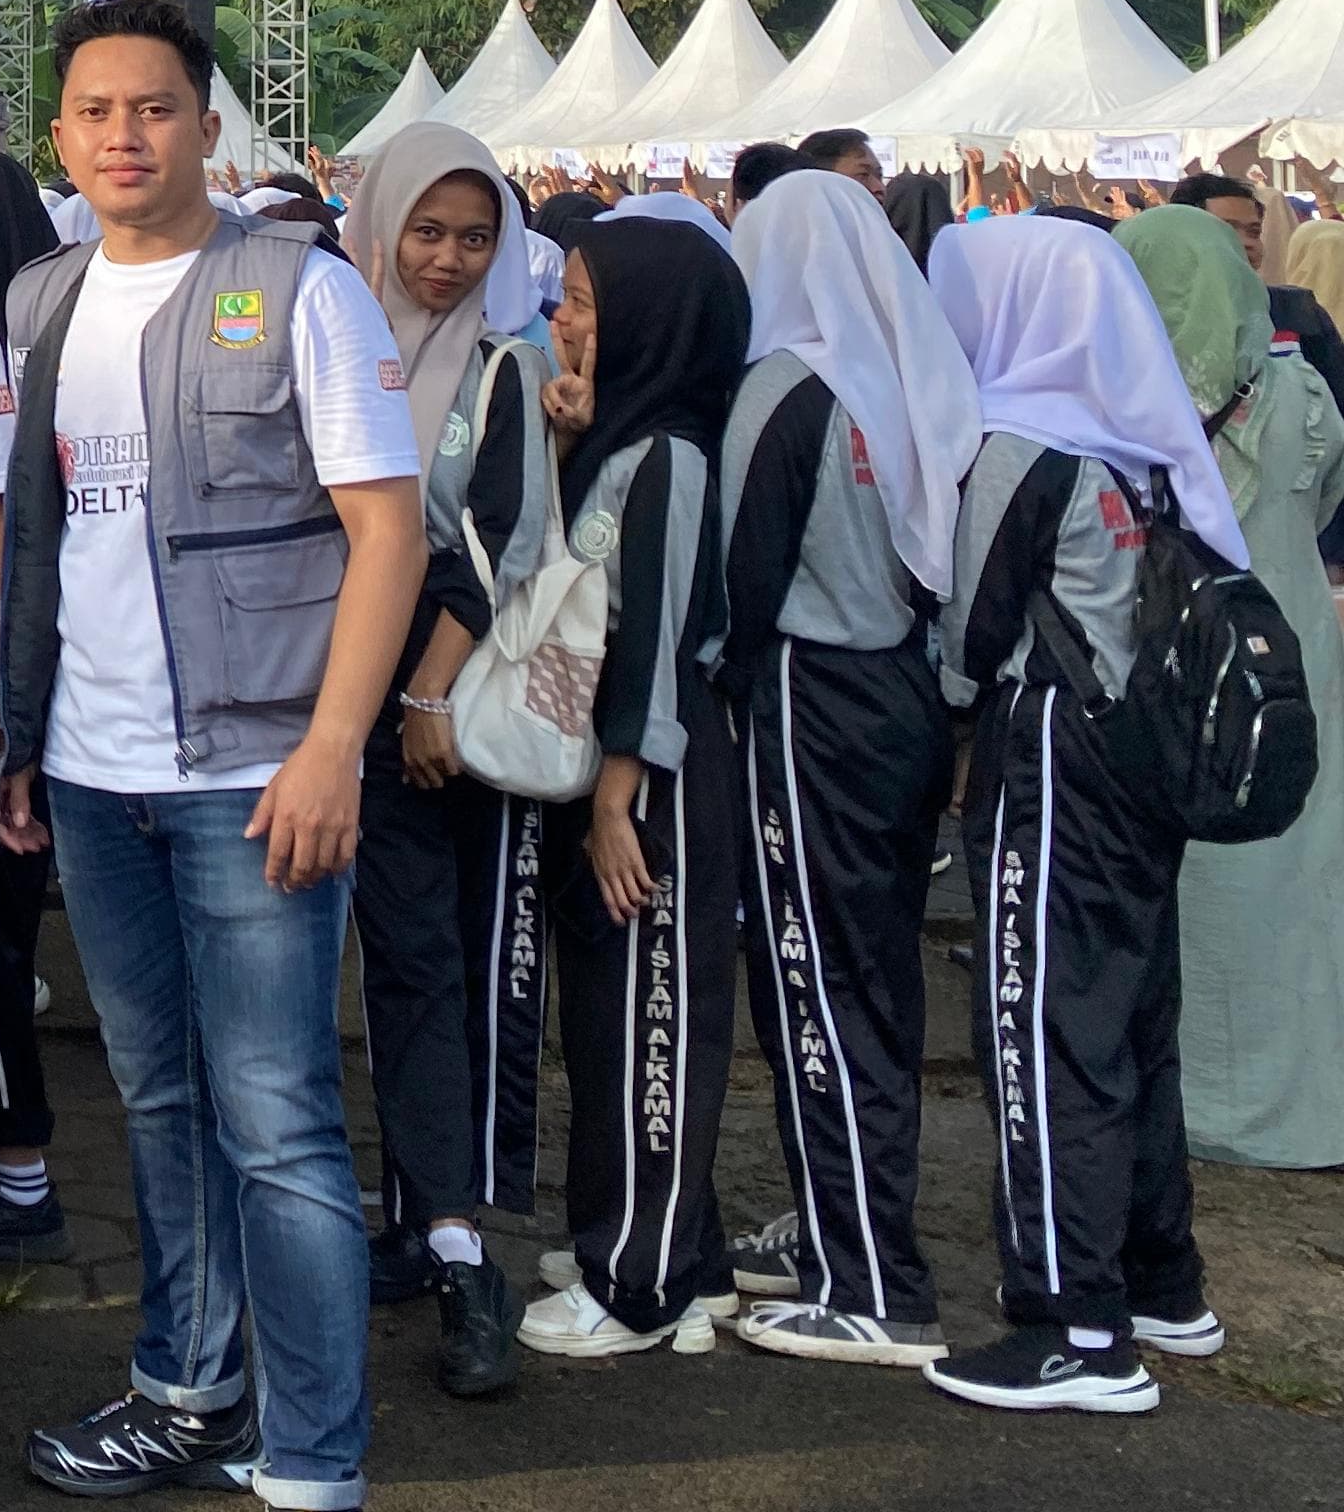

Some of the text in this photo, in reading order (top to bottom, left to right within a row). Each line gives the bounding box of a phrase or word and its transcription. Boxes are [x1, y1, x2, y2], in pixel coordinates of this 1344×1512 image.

[1001, 850, 1025, 905] SMA
[510, 885, 537, 999] ALKAMAL
[646, 934, 673, 1021] ISLAM
[999, 913, 1023, 1003] ISLAM
[643, 1028, 672, 1153] ALKAMAL
